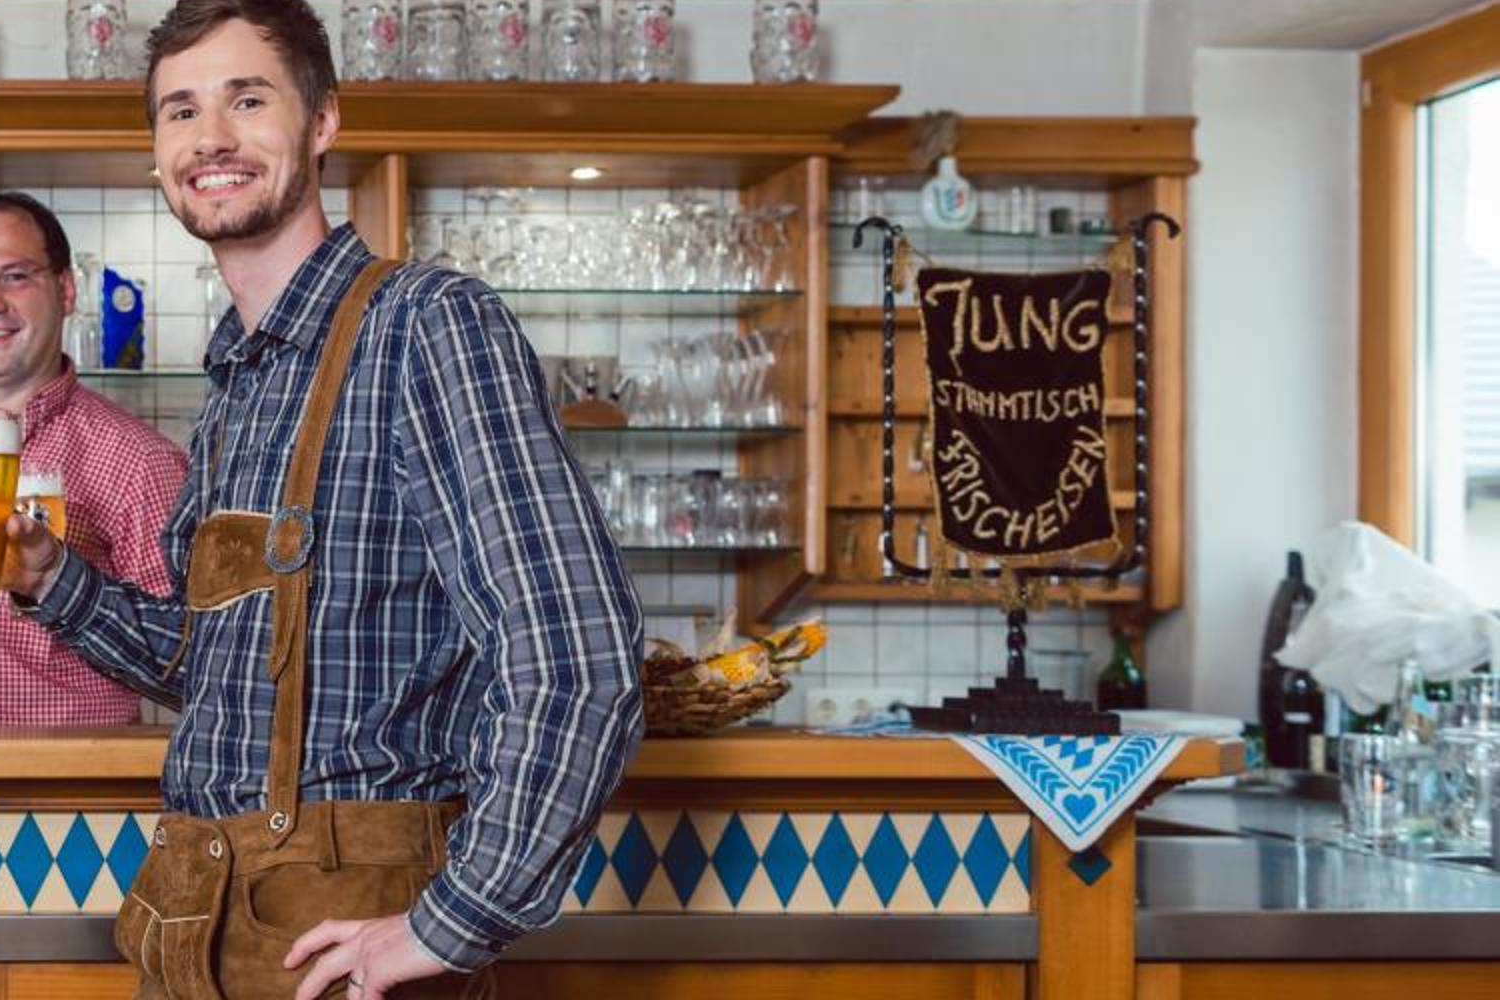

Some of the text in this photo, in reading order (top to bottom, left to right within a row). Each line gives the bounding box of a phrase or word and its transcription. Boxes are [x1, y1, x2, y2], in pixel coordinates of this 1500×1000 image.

[924, 277, 1100, 377] JUNG
[935, 379, 1100, 422] STAMMTISCH
[937, 425, 1106, 548] FRISCHEISEN
